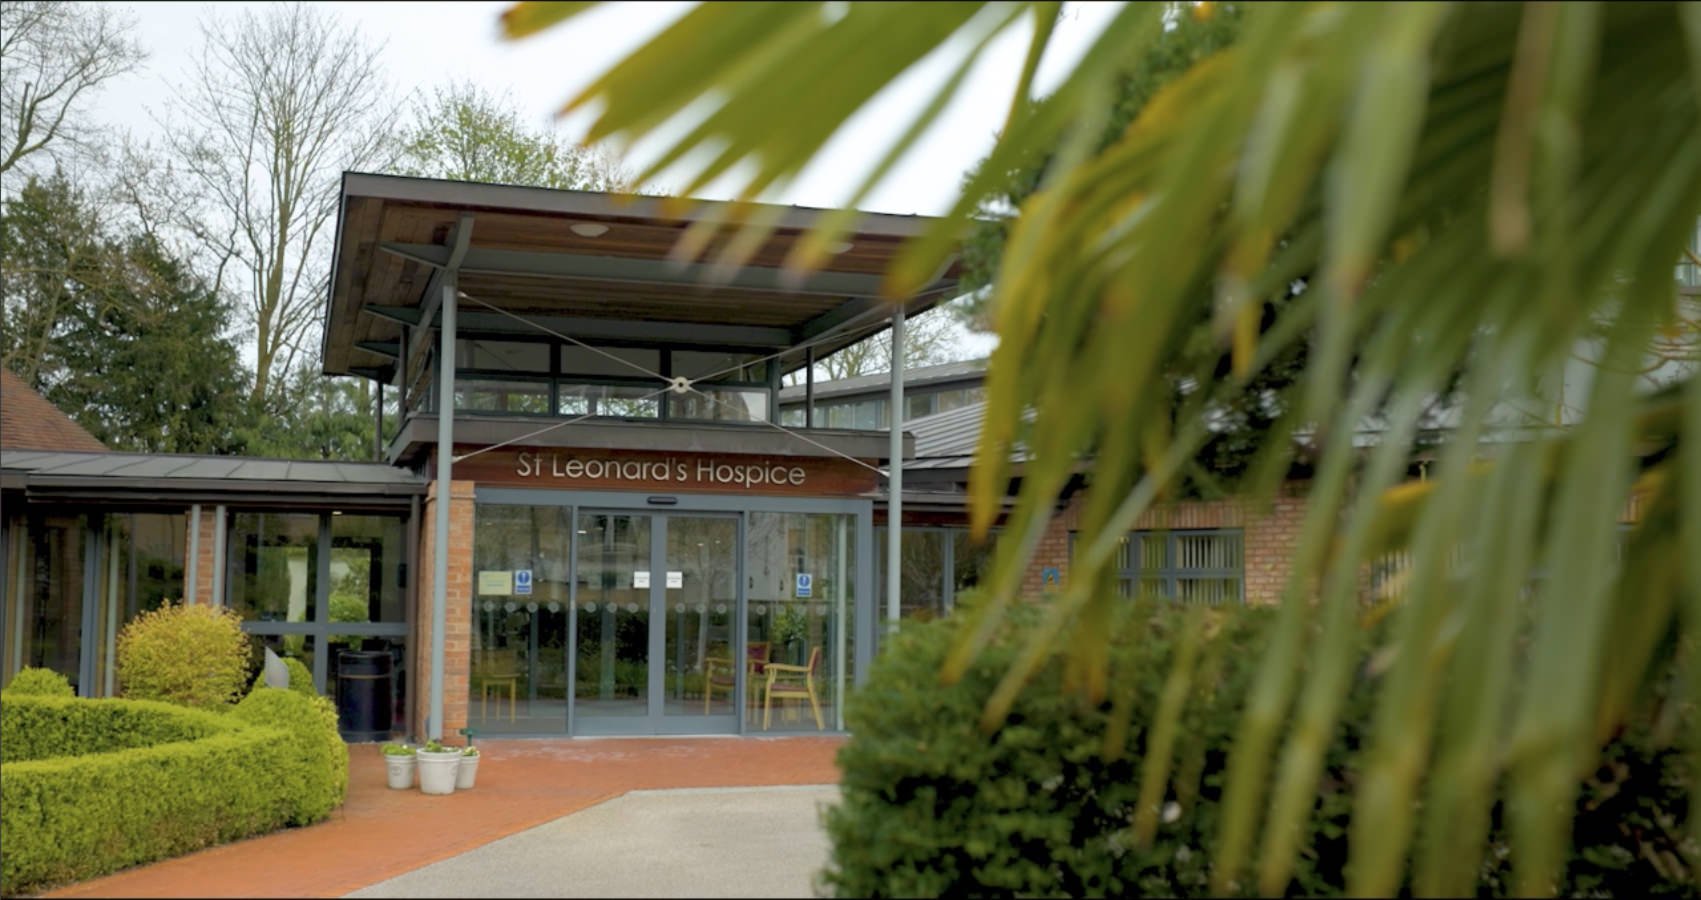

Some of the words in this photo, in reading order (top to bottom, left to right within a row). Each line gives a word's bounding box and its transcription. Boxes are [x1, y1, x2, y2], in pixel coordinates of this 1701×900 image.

[517, 452, 541, 477] St
[552, 456, 687, 482] Leonard's
[697, 459, 806, 488] Hospice
